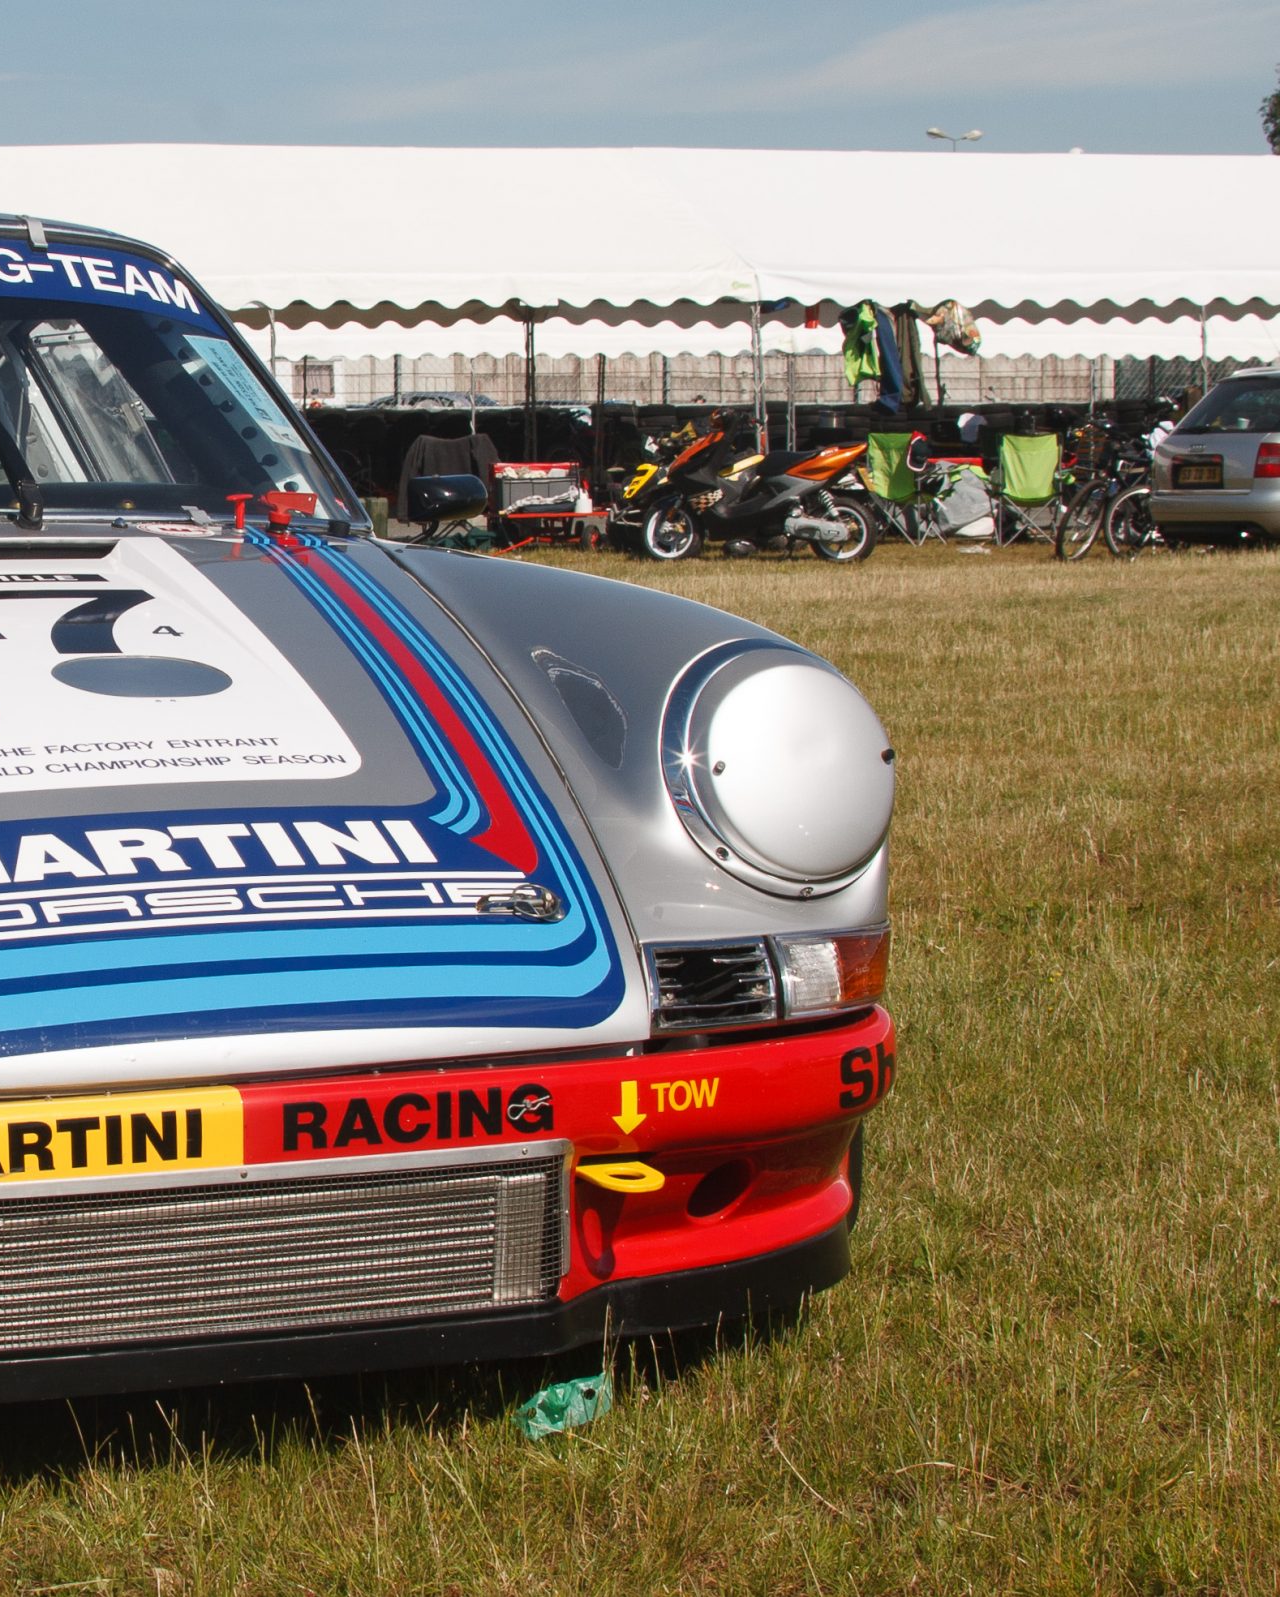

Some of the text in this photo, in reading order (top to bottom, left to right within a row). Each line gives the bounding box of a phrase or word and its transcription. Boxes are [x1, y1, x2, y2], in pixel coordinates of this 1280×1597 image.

[152, 625, 184, 637] 4
[44, 741, 154, 755] FACTORY
[166, 737, 280, 750] ENTRANT
[45, 756, 232, 774] CHAMPIONSHIP
[242, 754, 347, 766] SEASON
[650, 1077, 720, 1113] TOW
[282, 1083, 555, 1152] RACING
